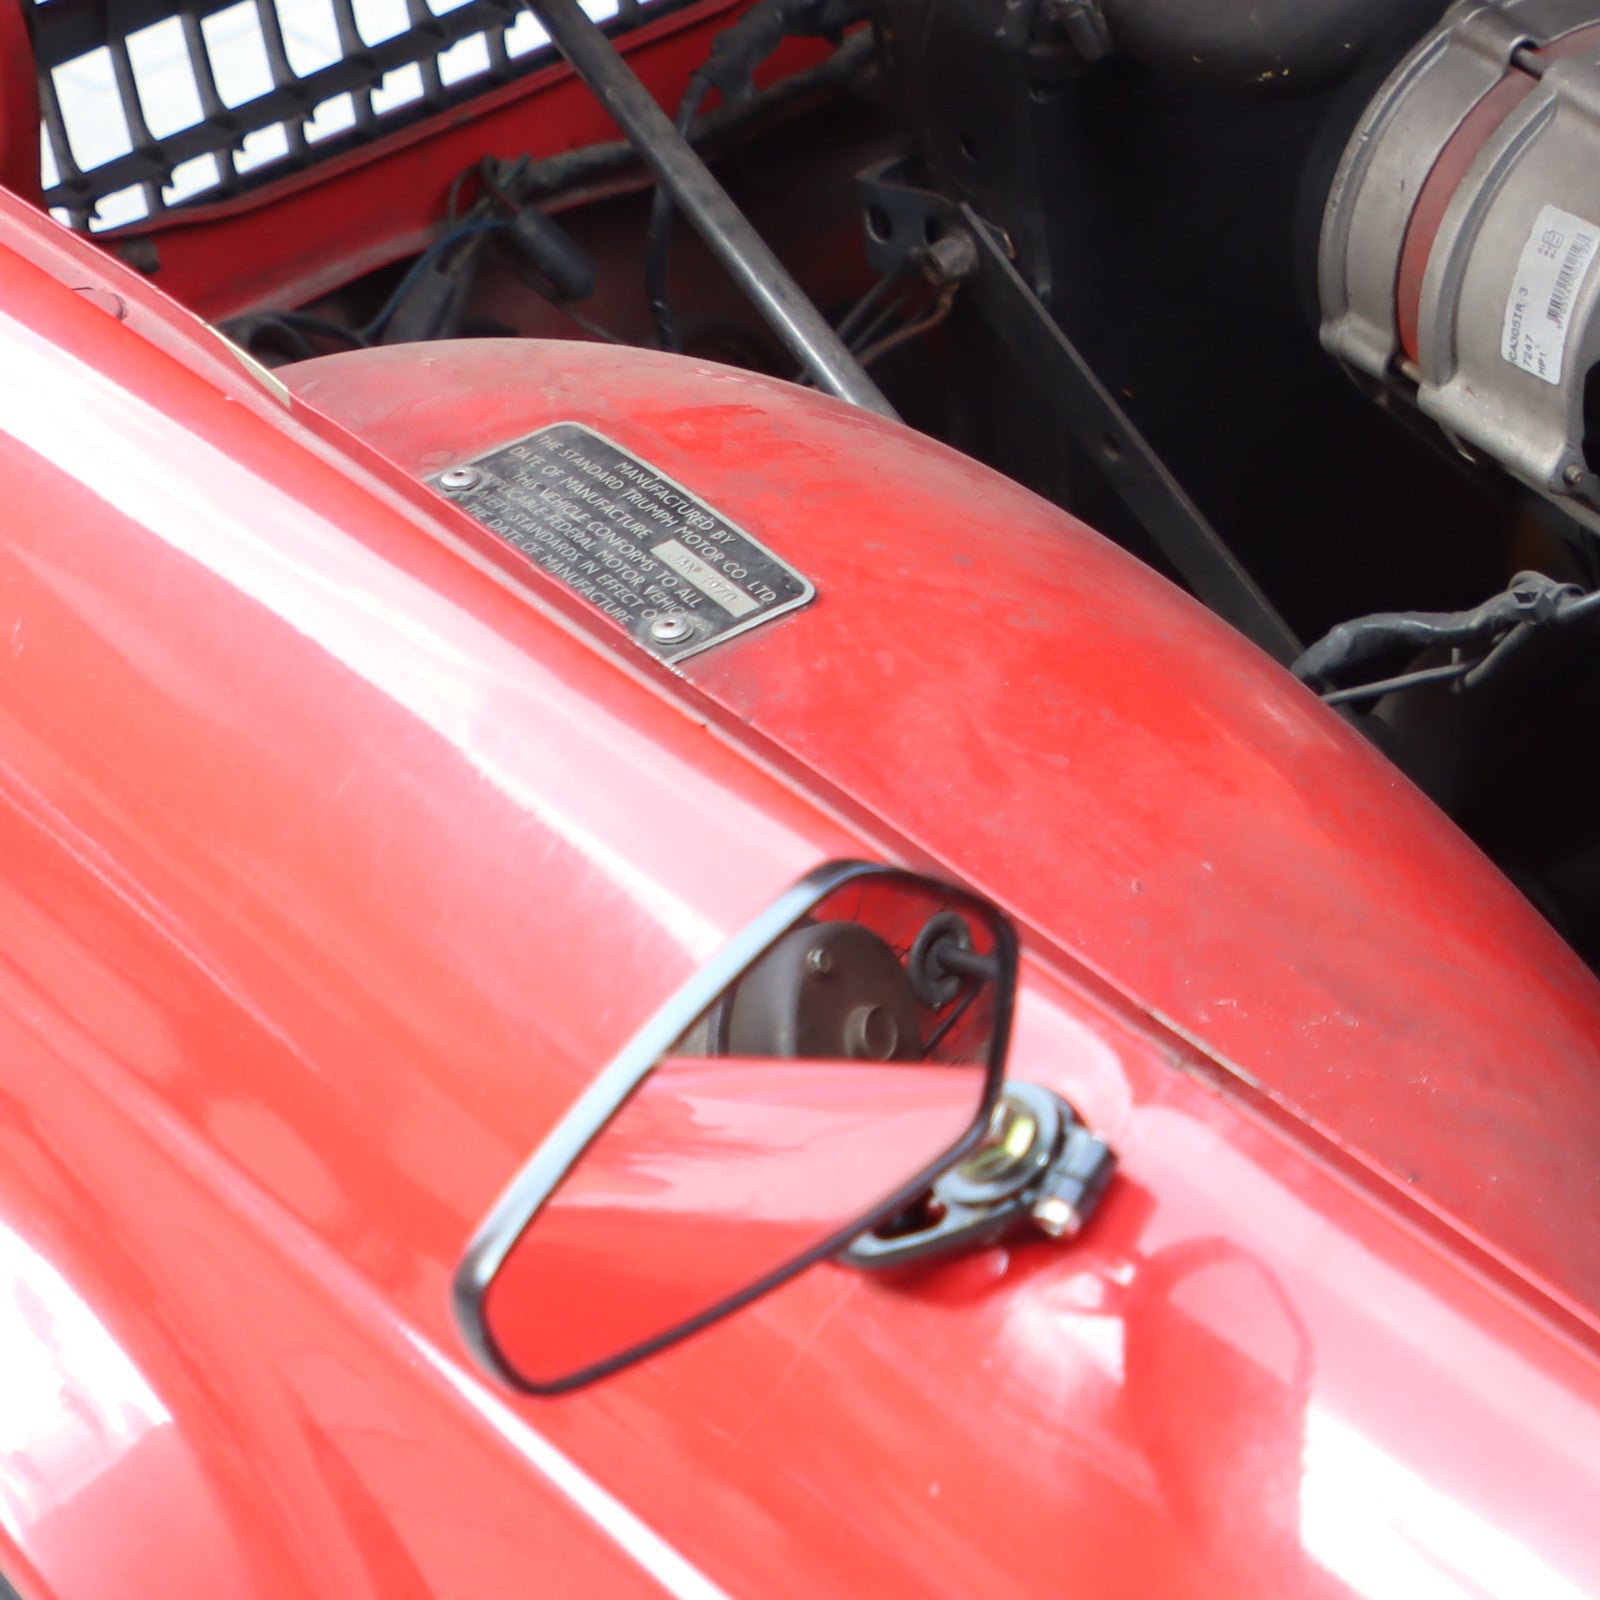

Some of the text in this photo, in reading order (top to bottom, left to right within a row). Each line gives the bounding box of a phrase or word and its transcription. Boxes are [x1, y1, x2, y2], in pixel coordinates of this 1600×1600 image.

[471, 488, 513, 514] AFETY
[510, 513, 582, 562] STANDARDS
[578, 560, 599, 574] IN
[596, 574, 643, 609] EFFECT
[508, 446, 546, 467] DATE
[541, 465, 564, 478] OF
[560, 477, 652, 539] MANUFACTURE
[511, 471, 704, 608] THIS VEHICLE CONFORMS TO ALL
[536, 435, 563, 451] THE
[559, 449, 625, 490] STANDARD
[620, 489, 677, 527] TRIUMPH
[674, 526, 725, 562] MOTOR
[544, 515, 599, 551] FEDERAL
[595, 550, 645, 586] MOTOR
[614, 462, 735, 546] MANUFACTURED BY
[463, 503, 633, 625] THE DATE OF MANUFACTURE
